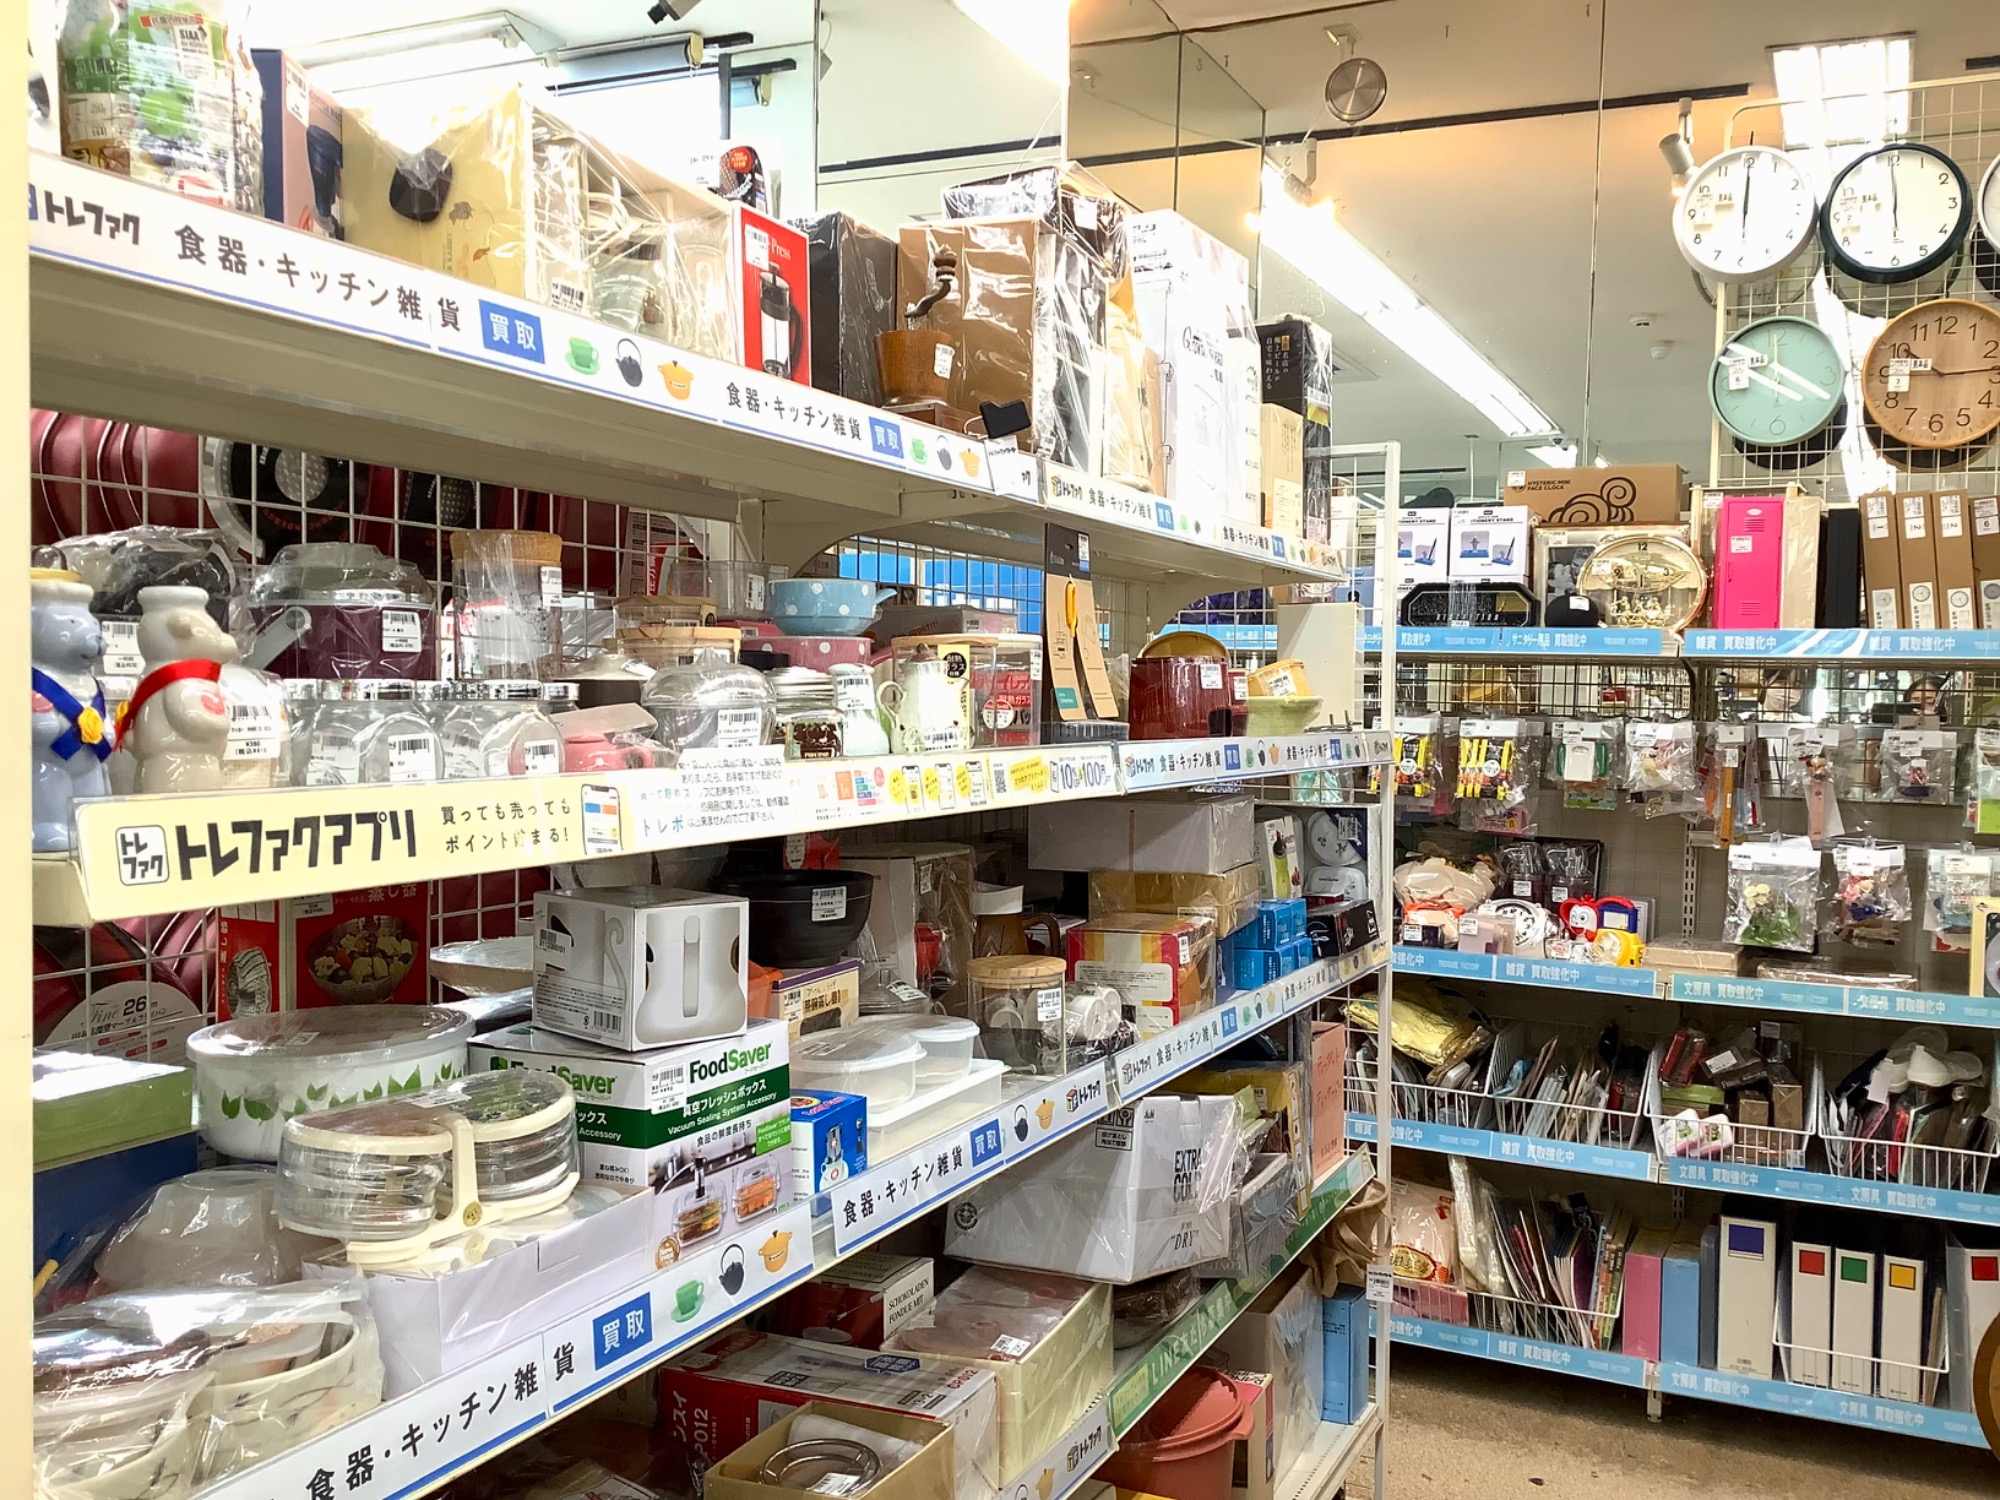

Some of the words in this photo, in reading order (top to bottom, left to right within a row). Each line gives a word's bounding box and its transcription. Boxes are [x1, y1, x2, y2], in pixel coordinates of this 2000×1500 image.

[179, 27, 199, 40] SIAA
[1718, 165, 1728, 177] 11
[1939, 172, 1950, 185] 2
[1948, 196, 1958, 209] 3
[1688, 209, 1696, 220] 9
[1938, 222, 1949, 235] 4
[771, 237, 791, 261] Press
[1694, 234, 1702, 244] 8
[1714, 250, 1722, 261] 7
[1918, 244, 1928, 257] 5
[1891, 255, 1901, 267] 6
[44, 191, 140, 246] トレファク
[175, 223, 461, 331] 食器・キッチン雑貨
[490, 313, 535, 353] 買取
[1910, 323, 1928, 342] 11
[1934, 315, 1959, 335] 12
[1968, 322, 1977, 341] 1
[1887, 342, 1910, 359] 10
[1983, 340, 1999, 359] 2
[1884, 391, 1899, 409] 8
[1977, 389, 1994, 409] 4
[727, 381, 862, 441] 食器・キッチン雑貨
[874, 425, 898, 453] 買取
[1768, 415, 1786, 436] 6
[1904, 407, 1918, 426] 7
[1928, 413, 1944, 433] 6
[1956, 407, 1971, 426] 5
[1088, 488, 1152, 520] 食器・キッチン雑貨
[1637, 543, 1648, 551] 12
[1401, 632, 1431, 646] 買取強化中
[1555, 634, 1587, 648] 買取強化中
[1696, 635, 1717, 650] 雑貨
[1724, 636, 1777, 651] 買取強化中
[1869, 636, 1892, 652] 雑貨
[1899, 636, 1955, 652] 買取強化中
[1160, 749, 1221, 773] 食器・キッチン雑貨
[442, 799, 572, 826] 買っても売っても
[642, 815, 684, 838] トレポ
[120, 832, 148, 856] トレ
[175, 809, 417, 882] トレファクアプリ
[123, 856, 163, 879] ファク
[1392, 952, 1425, 967] 強化中
[1506, 962, 1526, 978] 雑貨
[1531, 964, 1580, 982] 買取強化中
[1683, 981, 1711, 997] 文房具
[1717, 983, 1764, 1001] 買取強化中
[1895, 996, 1946, 1016] 買取強化中
[1132, 1054, 1152, 1079] トレファク
[1156, 1020, 1219, 1067] 食器・キッチン雑貨
[690, 1043, 772, 1083] FoodSaver
[683, 1079, 767, 1118] 真空フレッシュボックス
[668, 1120, 695, 1135] Vacuum
[697, 1112, 721, 1126] Sealing
[722, 1103, 745, 1119] System
[746, 1092, 777, 1107] Accessory
[579, 1127, 621, 1141] Accessory
[697, 1119, 752, 1146] 食品の鮮度長持ち
[1391, 1125, 1423, 1142] 強化中
[843, 1146, 963, 1229] 食器・キッチン雑貨
[974, 1129, 998, 1158] 買取
[1078, 1080, 1101, 1106] トレファク
[1175, 1148, 1202, 1173] EXTRA
[1501, 1141, 1520, 1156] 雑貨
[1527, 1143, 1575, 1163] 買取強化中
[1679, 1165, 1706, 1181] 文房具
[1712, 1167, 1759, 1186] 買取強化中
[1851, 1186, 1880, 1204] 文房具
[1887, 1190, 1937, 1210] 買取強化中
[888, 1278, 929, 1311] SCHOKOLADEN
[888, 1305, 913, 1324] FONDUE
[913, 1296, 925, 1309] MIT
[1390, 1319, 1423, 1338] 強化中
[1498, 1340, 1517, 1356] 雑貨
[1522, 1342, 1571, 1366] 買取強化中
[946, 1367, 979, 1391] CP012
[1671, 1373, 1698, 1390] 文房具
[1704, 1377, 1750, 1397] 買取強化中
[305, 1342, 576, 1500] 食器・キッチン雑貨
[601, 1309, 646, 1350] 買取
[1840, 1401, 1868, 1418] 文房具
[1875, 1405, 1924, 1427] 買取強化中
[694, 1407, 709, 1458] P012
[1078, 1424, 1102, 1458] トレファク
